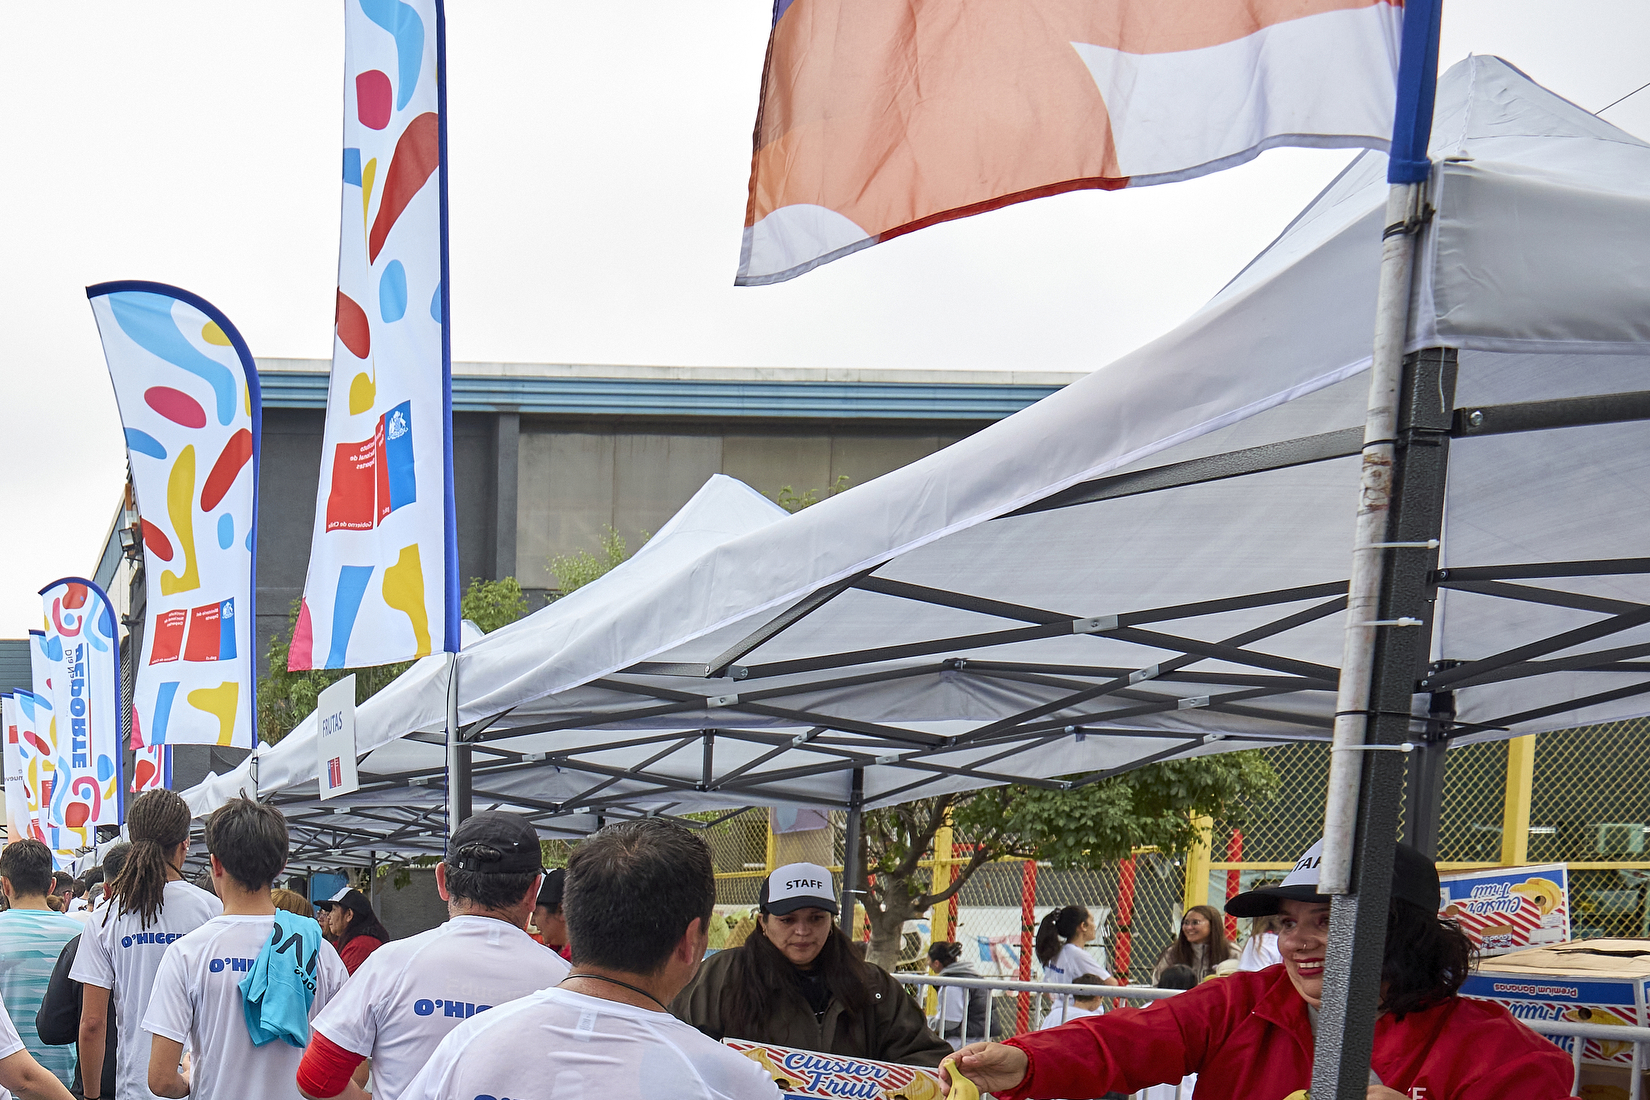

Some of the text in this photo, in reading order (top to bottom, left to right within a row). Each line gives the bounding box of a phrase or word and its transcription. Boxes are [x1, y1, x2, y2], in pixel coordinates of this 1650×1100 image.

[786, 879, 823, 890] STAFF
[1494, 982, 1578, 998] Premium Bananas
[784, 1053, 889, 1080] Cluster
[806, 1070, 880, 1100] Fruit
